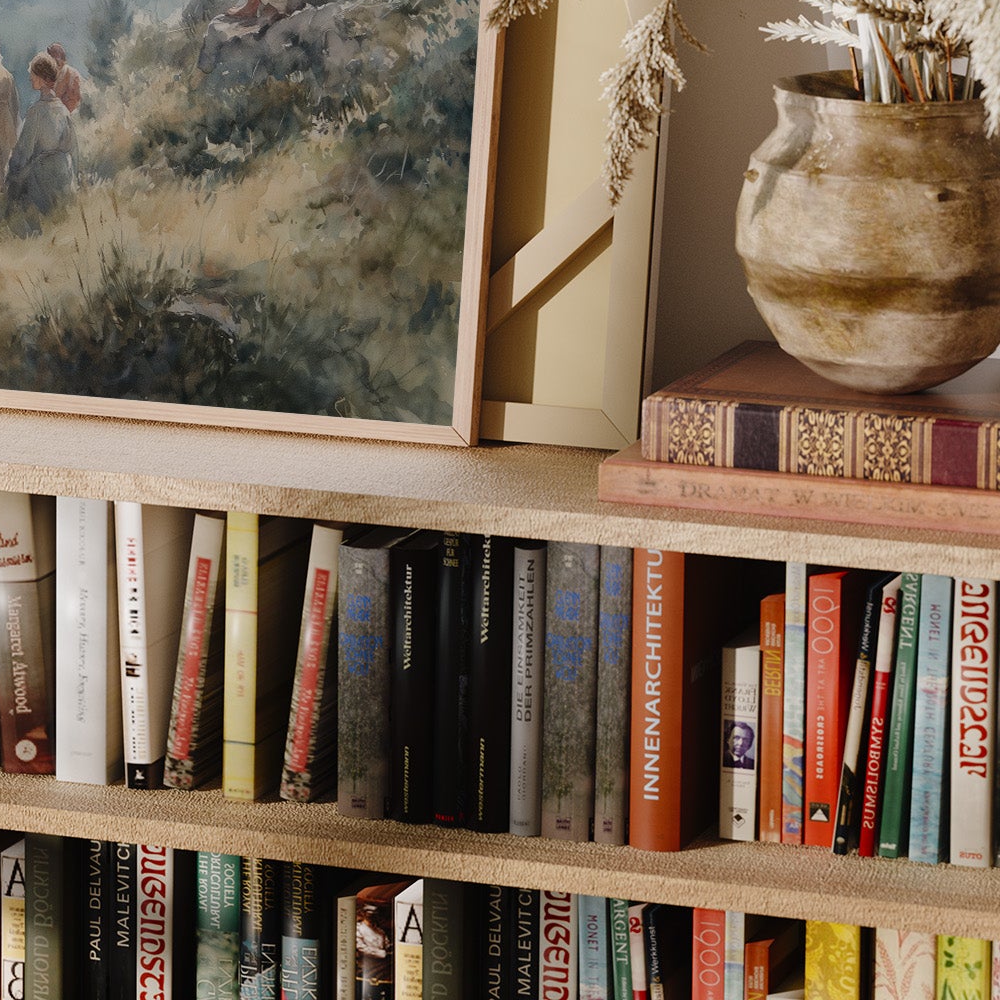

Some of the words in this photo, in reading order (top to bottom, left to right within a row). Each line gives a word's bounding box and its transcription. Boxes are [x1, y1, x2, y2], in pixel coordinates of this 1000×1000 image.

[403, 564, 413, 670] Weltarchitektur
[480, 534, 491, 645] Weltarchitek
[525, 559, 535, 678] PRIMZAHLEN
[6, 595, 24, 657] Margaret
[517, 576, 526, 686] EINSAMKEIT
[12, 661, 32, 714] Atwood
[524, 685, 532, 722] DER
[643, 549, 664, 802] INNENARCHITEKTU
[516, 695, 524, 722] DIE
[90, 839, 102, 909] DELVAU
[89, 916, 101, 961] PAUL
[587, 914, 598, 952] MONET
[613, 898, 629, 965] ARGENT
[648, 926, 660, 974] Werkkunst
[696, 922, 721, 986] 1900
